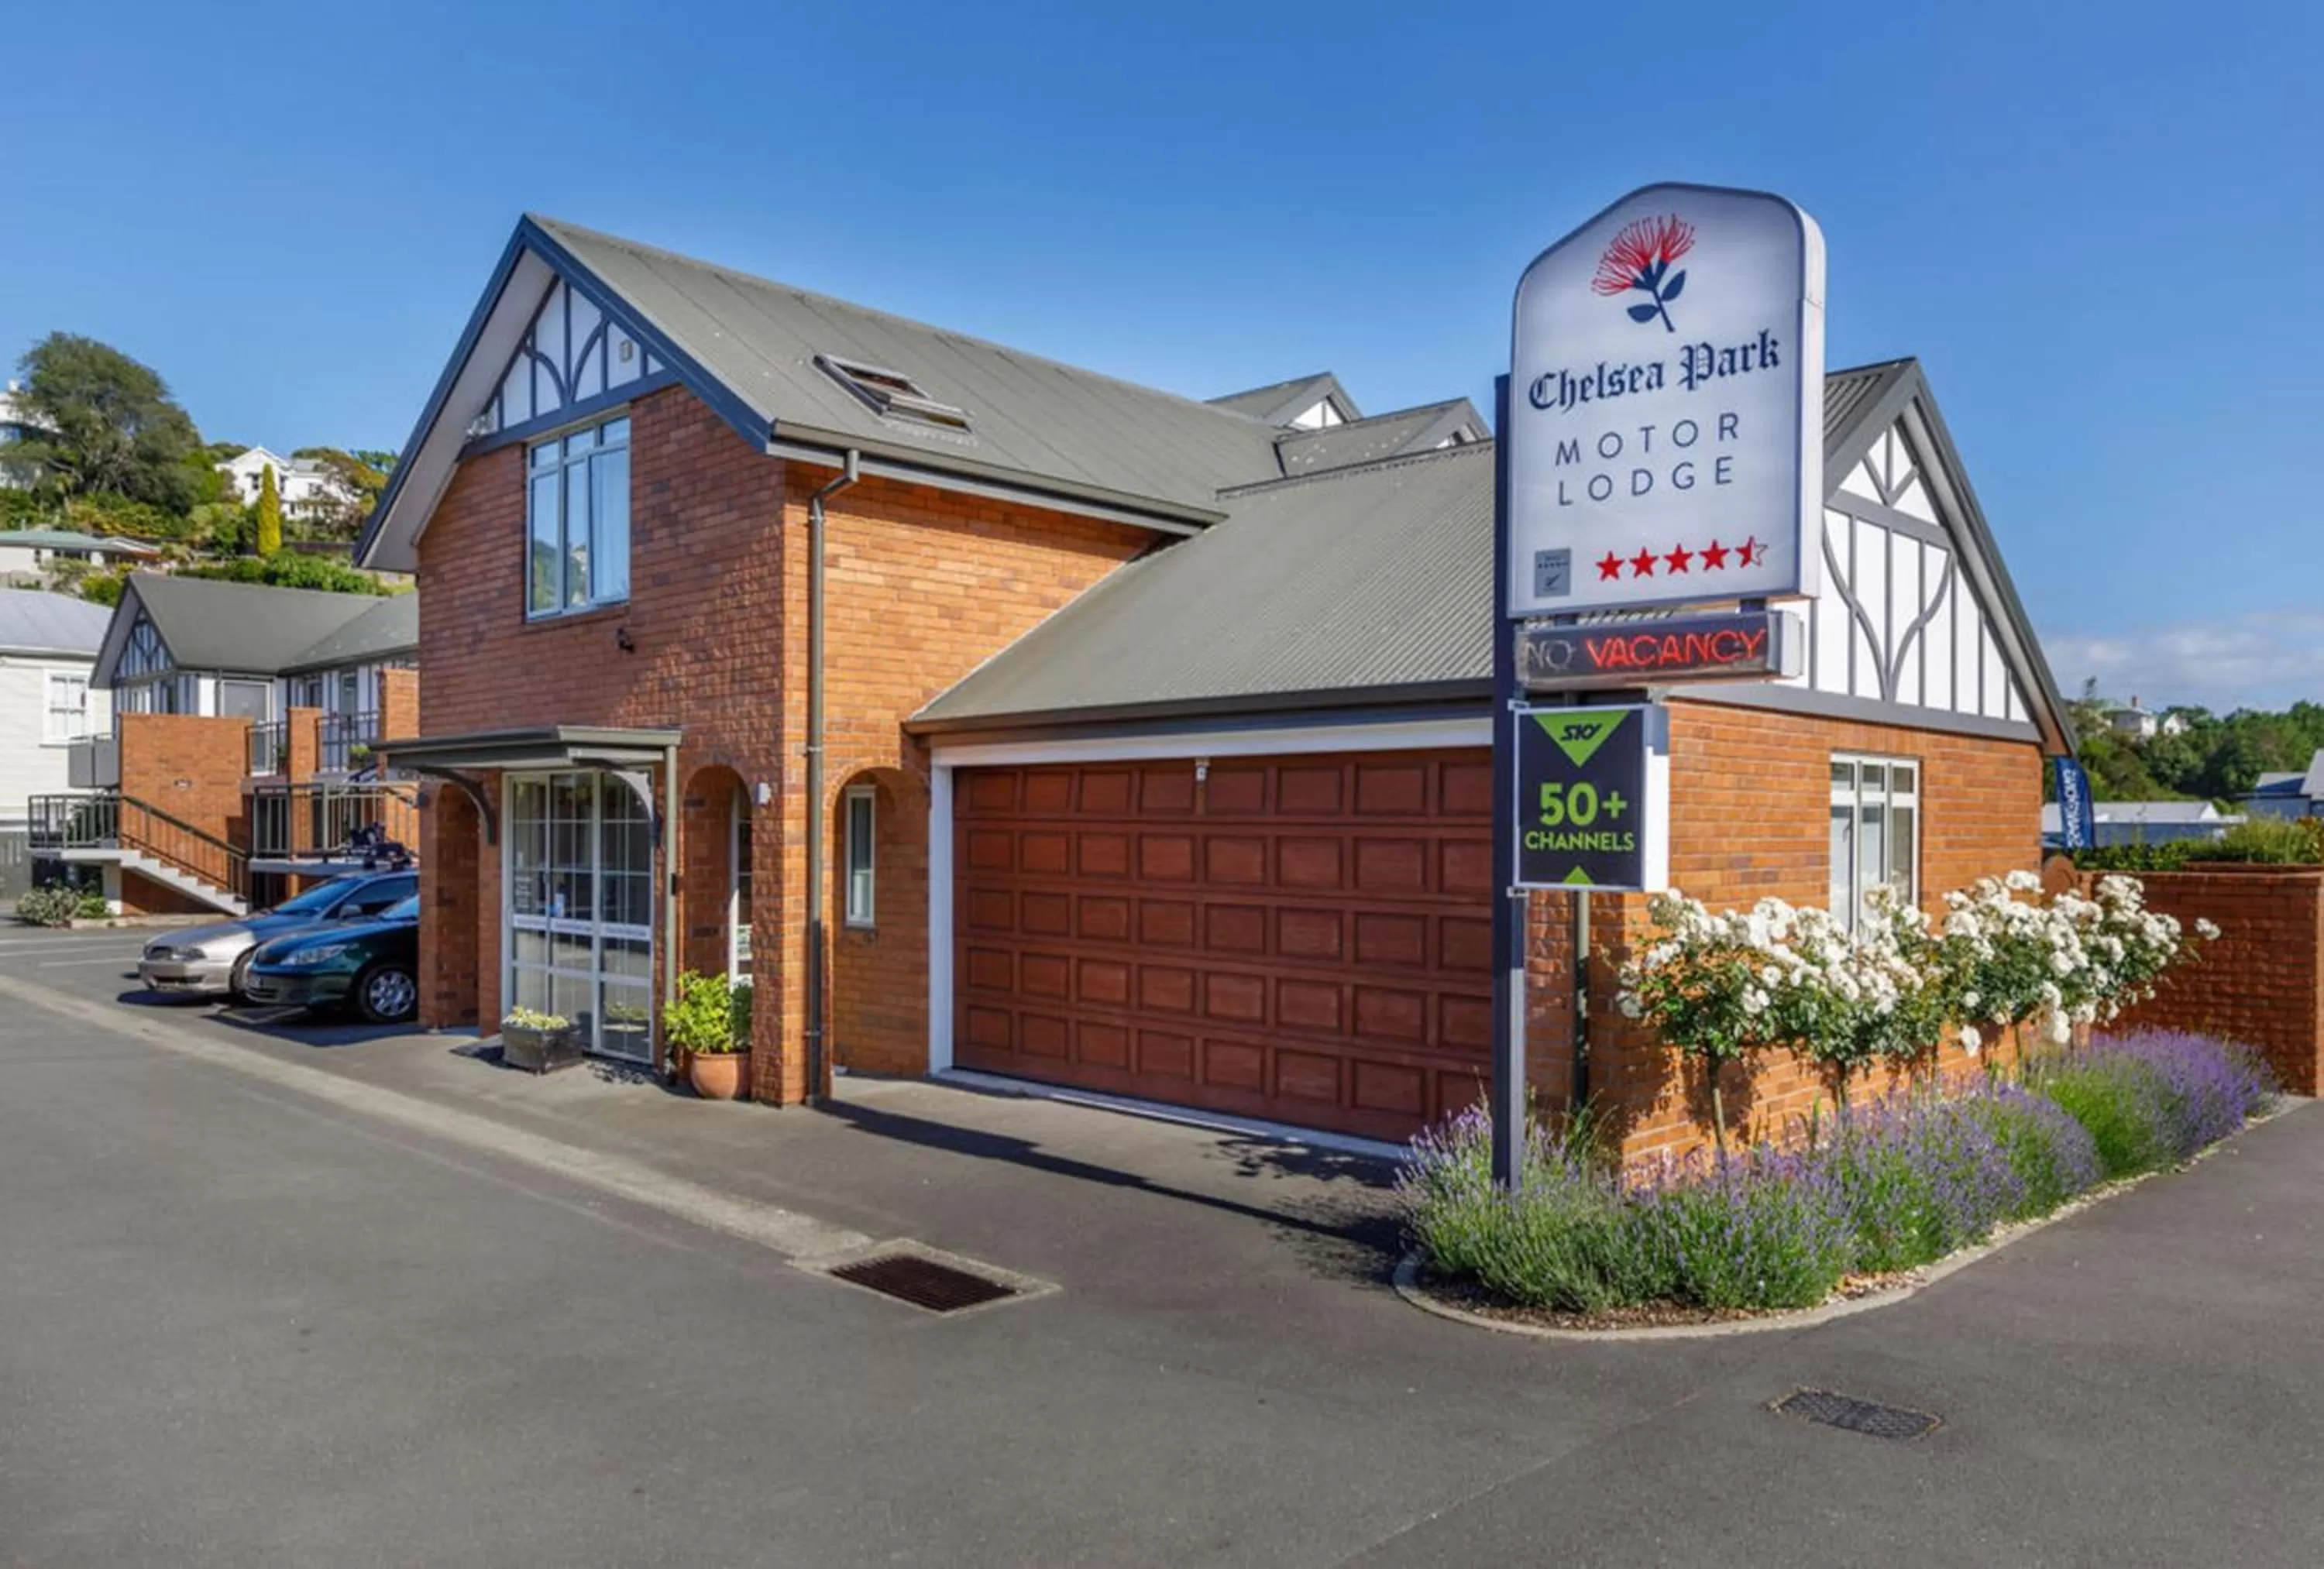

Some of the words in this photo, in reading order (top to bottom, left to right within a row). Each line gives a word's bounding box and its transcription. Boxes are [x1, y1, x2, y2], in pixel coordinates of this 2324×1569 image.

[1529, 361, 1665, 413] Chelsea
[1677, 329, 1779, 391] Park
[1555, 413, 1740, 466] MOTOR
[1559, 456, 1734, 506] LODGE
[1525, 639, 1573, 670] NO
[1586, 628, 1765, 668] VACANCY
[1539, 782, 1627, 826] 50+
[1525, 830, 1635, 851] CHANNELS
